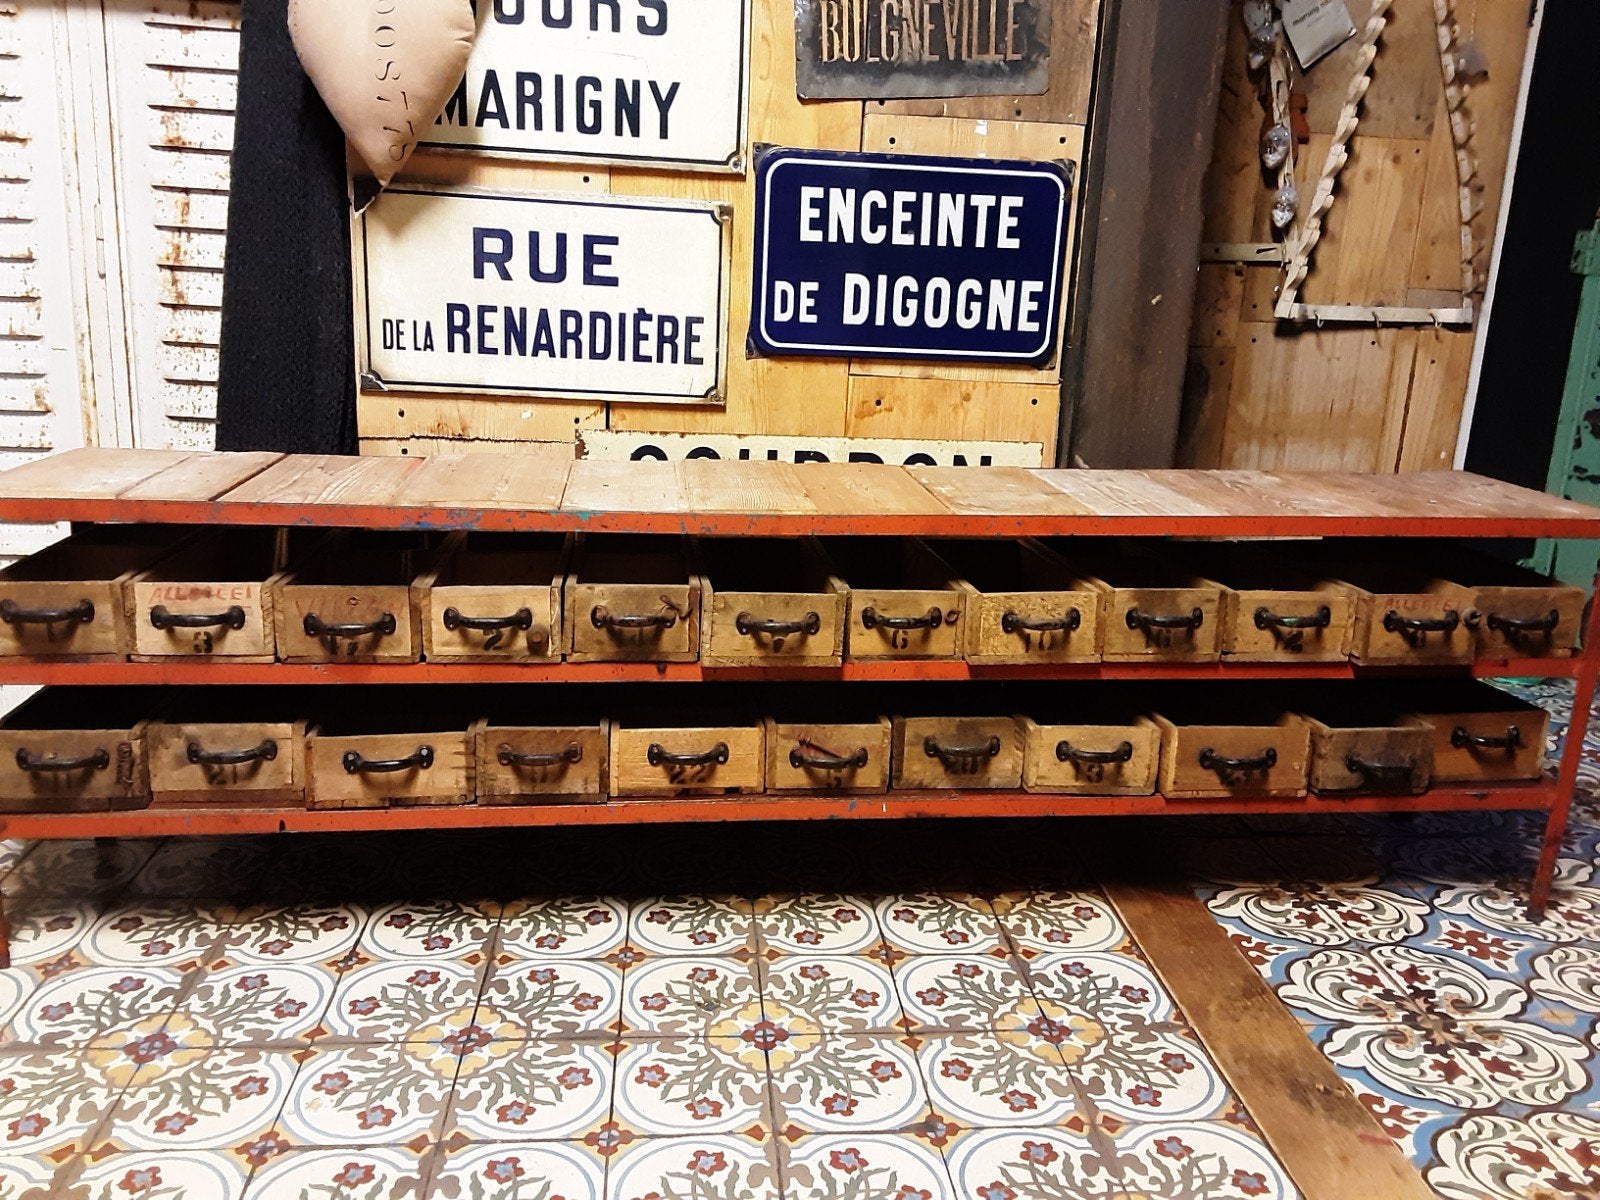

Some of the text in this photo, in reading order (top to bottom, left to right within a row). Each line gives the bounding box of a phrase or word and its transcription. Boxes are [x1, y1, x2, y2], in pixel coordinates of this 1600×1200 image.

[434, 69, 680, 140] MARIGNY
[800, 186, 1024, 249] ENCEINTE
[473, 226, 619, 287] RUE
[773, 272, 1044, 332] DE DIGOGNE
[382, 303, 704, 365] DE LA RENARDIÈRE
[482, 629, 503, 651] 2
